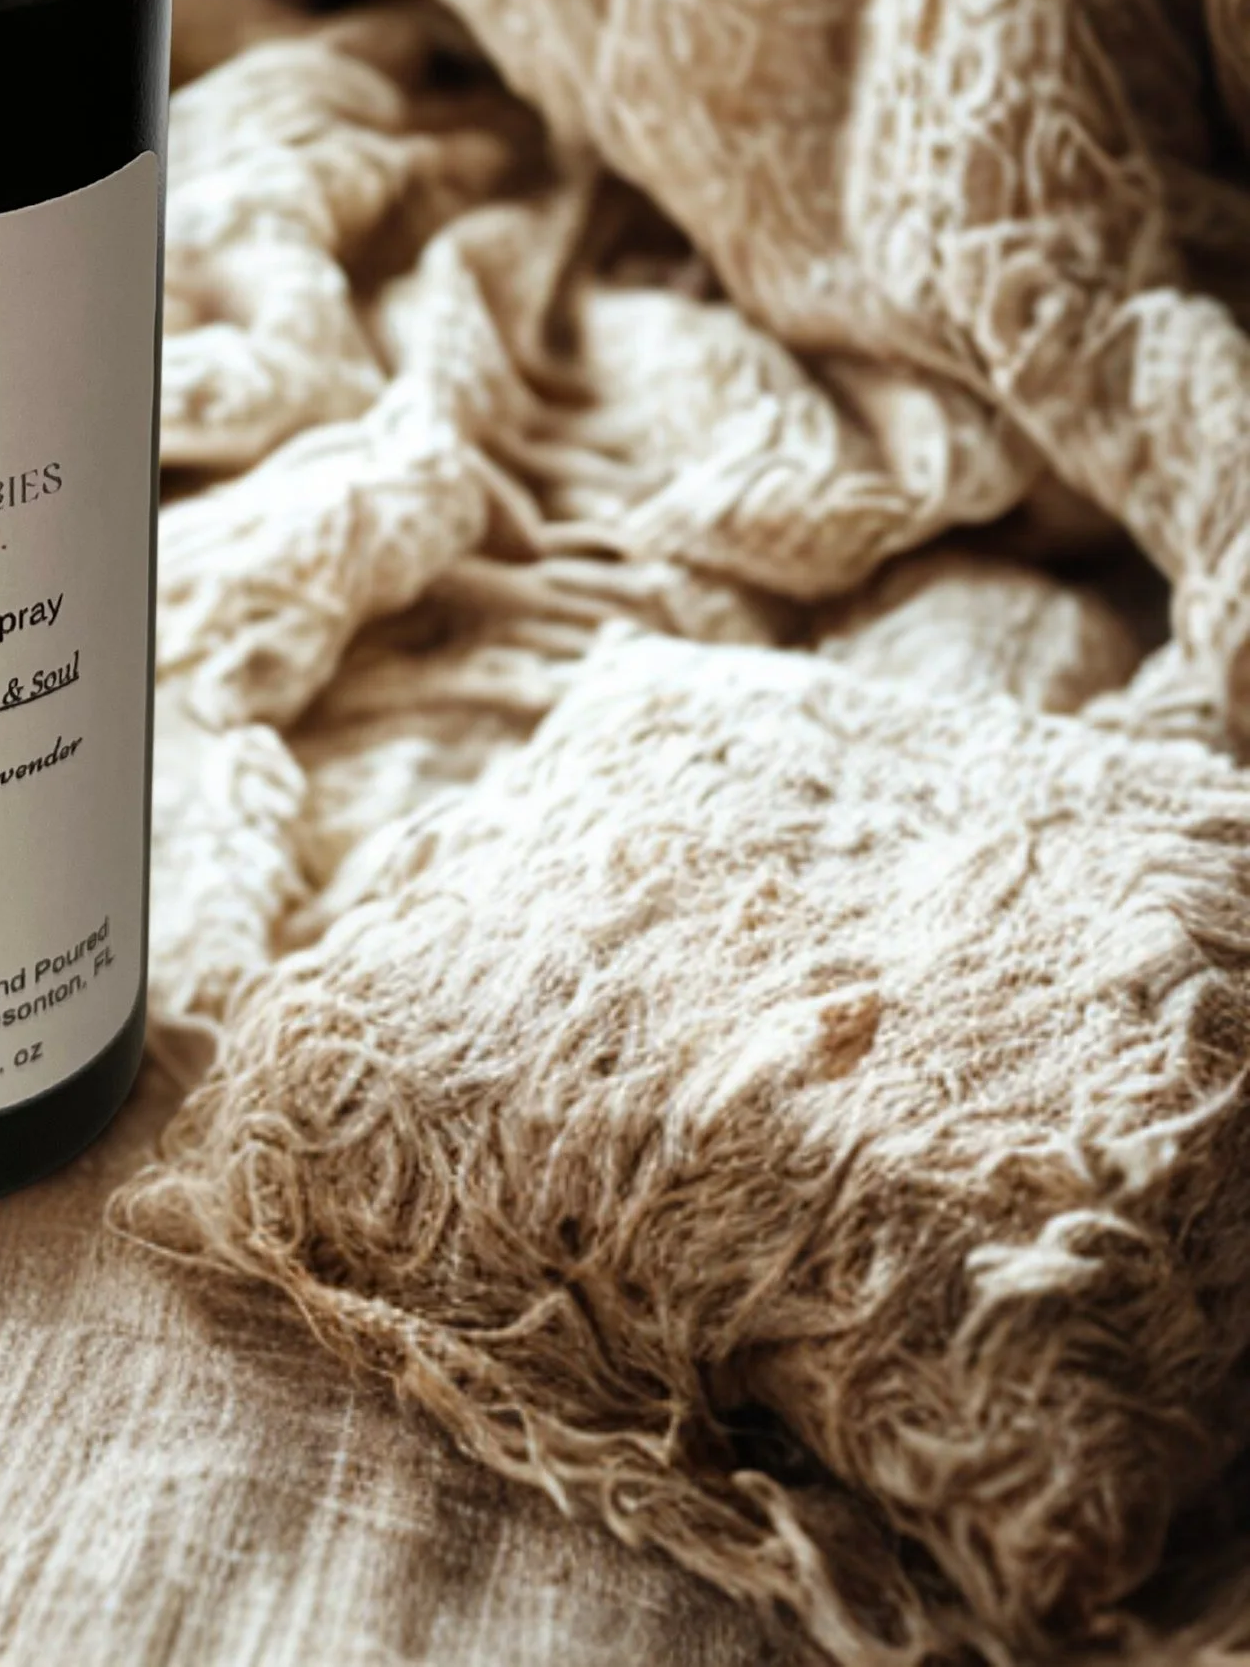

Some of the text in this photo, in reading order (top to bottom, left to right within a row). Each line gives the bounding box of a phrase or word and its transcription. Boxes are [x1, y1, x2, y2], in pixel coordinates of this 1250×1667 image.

[2, 677, 24, 705] &
[29, 649, 80, 696] Soul
[34, 914, 110, 983] Poured
[93, 945, 115, 977] FL
[13, 1041, 43, 1068] oz
